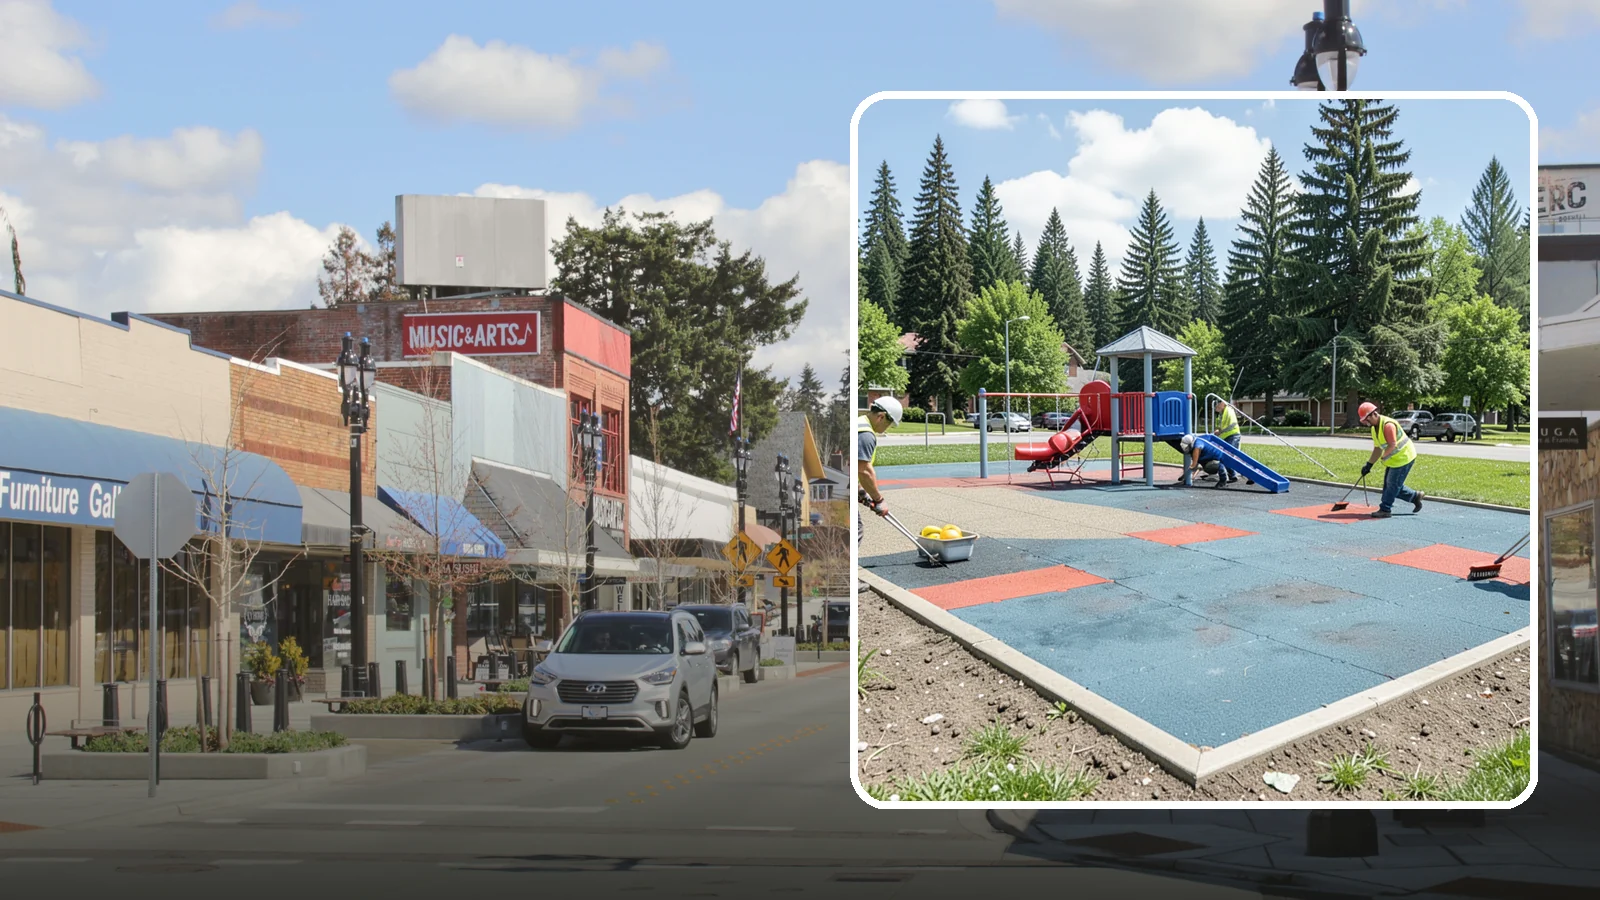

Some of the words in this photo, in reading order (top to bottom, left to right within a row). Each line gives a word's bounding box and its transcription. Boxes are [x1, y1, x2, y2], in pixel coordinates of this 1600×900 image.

[1540, 428, 1577, 436] UGA
[0, 471, 79, 515] Furniture
[89, 482, 122, 519] Gal
